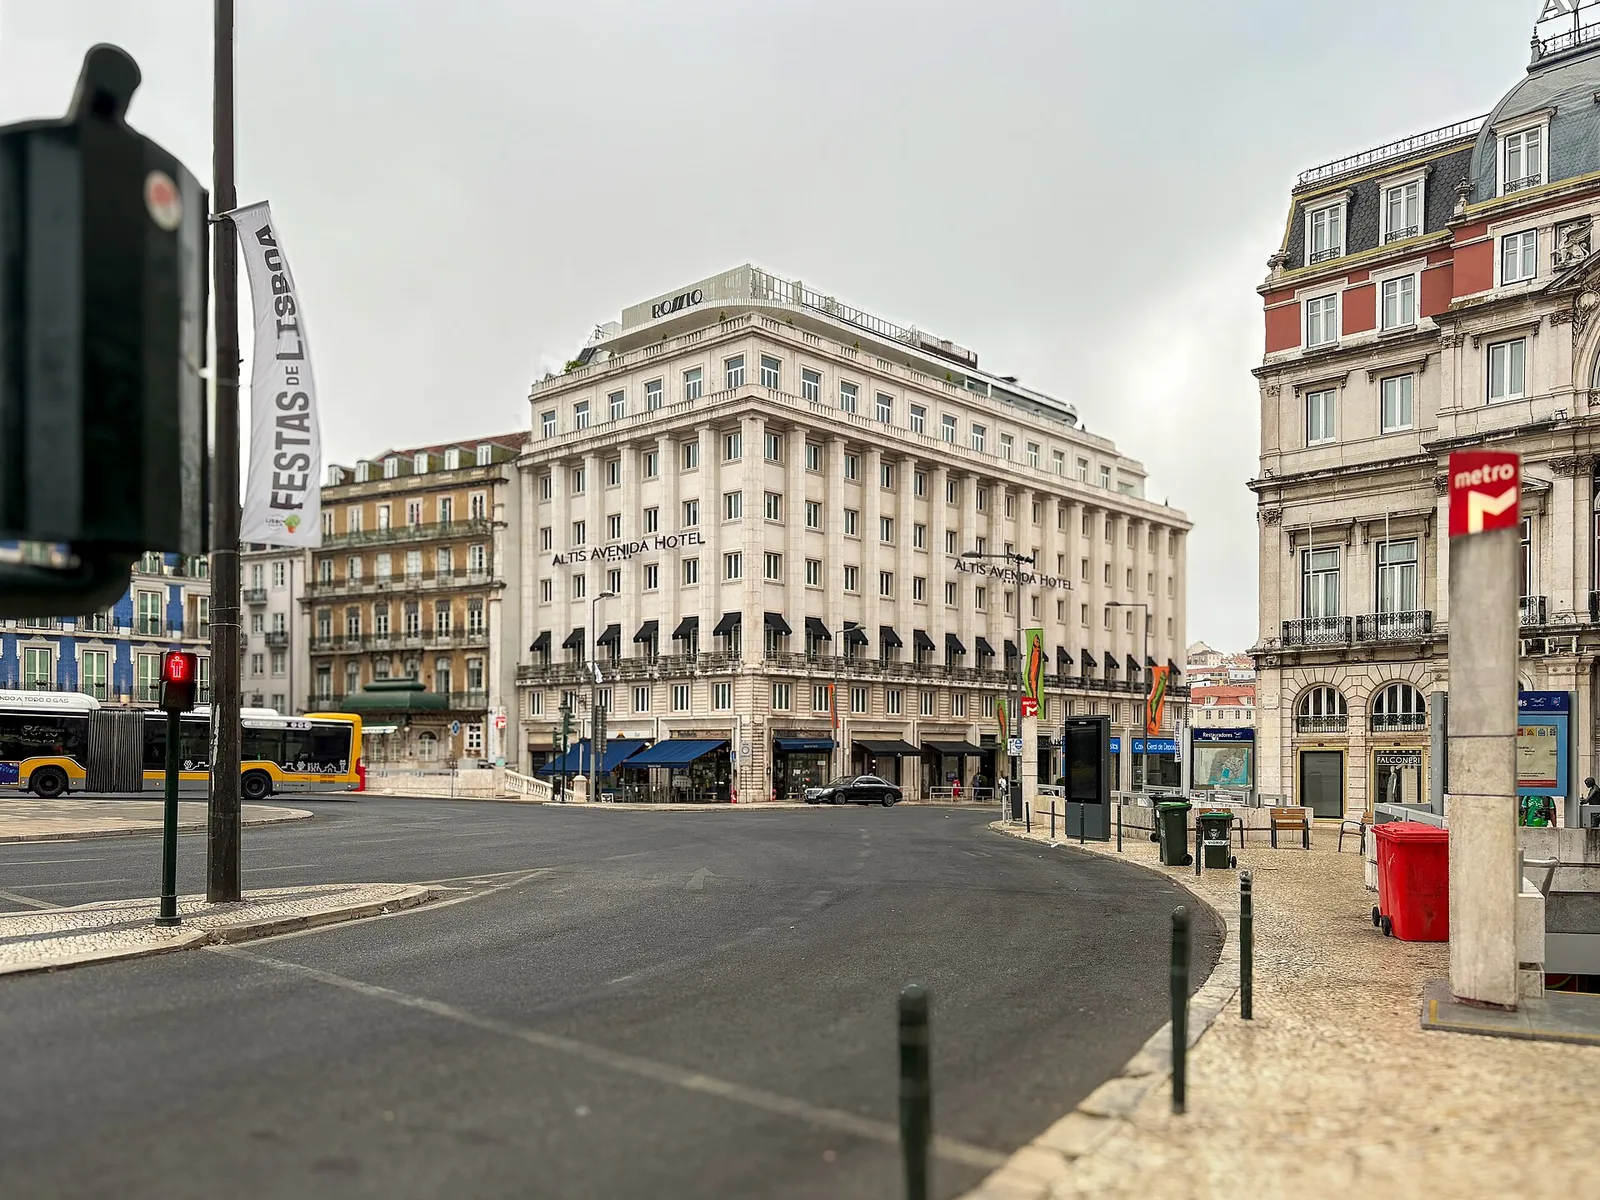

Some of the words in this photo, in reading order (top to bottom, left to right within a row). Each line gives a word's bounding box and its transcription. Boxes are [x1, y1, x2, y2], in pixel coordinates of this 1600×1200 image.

[254, 224, 305, 361] LISBOA
[285, 365, 300, 386] DE
[269, 391, 311, 510] FESTAS
[1454, 463, 1515, 490] metro
[552, 550, 587, 566] ALTIS
[590, 540, 650, 561] AVENIDA
[654, 531, 706, 550] HOTEL
[954, 559, 986, 575] ALTIS
[989, 565, 1037, 584] AVENDA
[1040, 573, 1074, 591] HOTEL
[1376, 756, 1421, 764] FALCONERI
